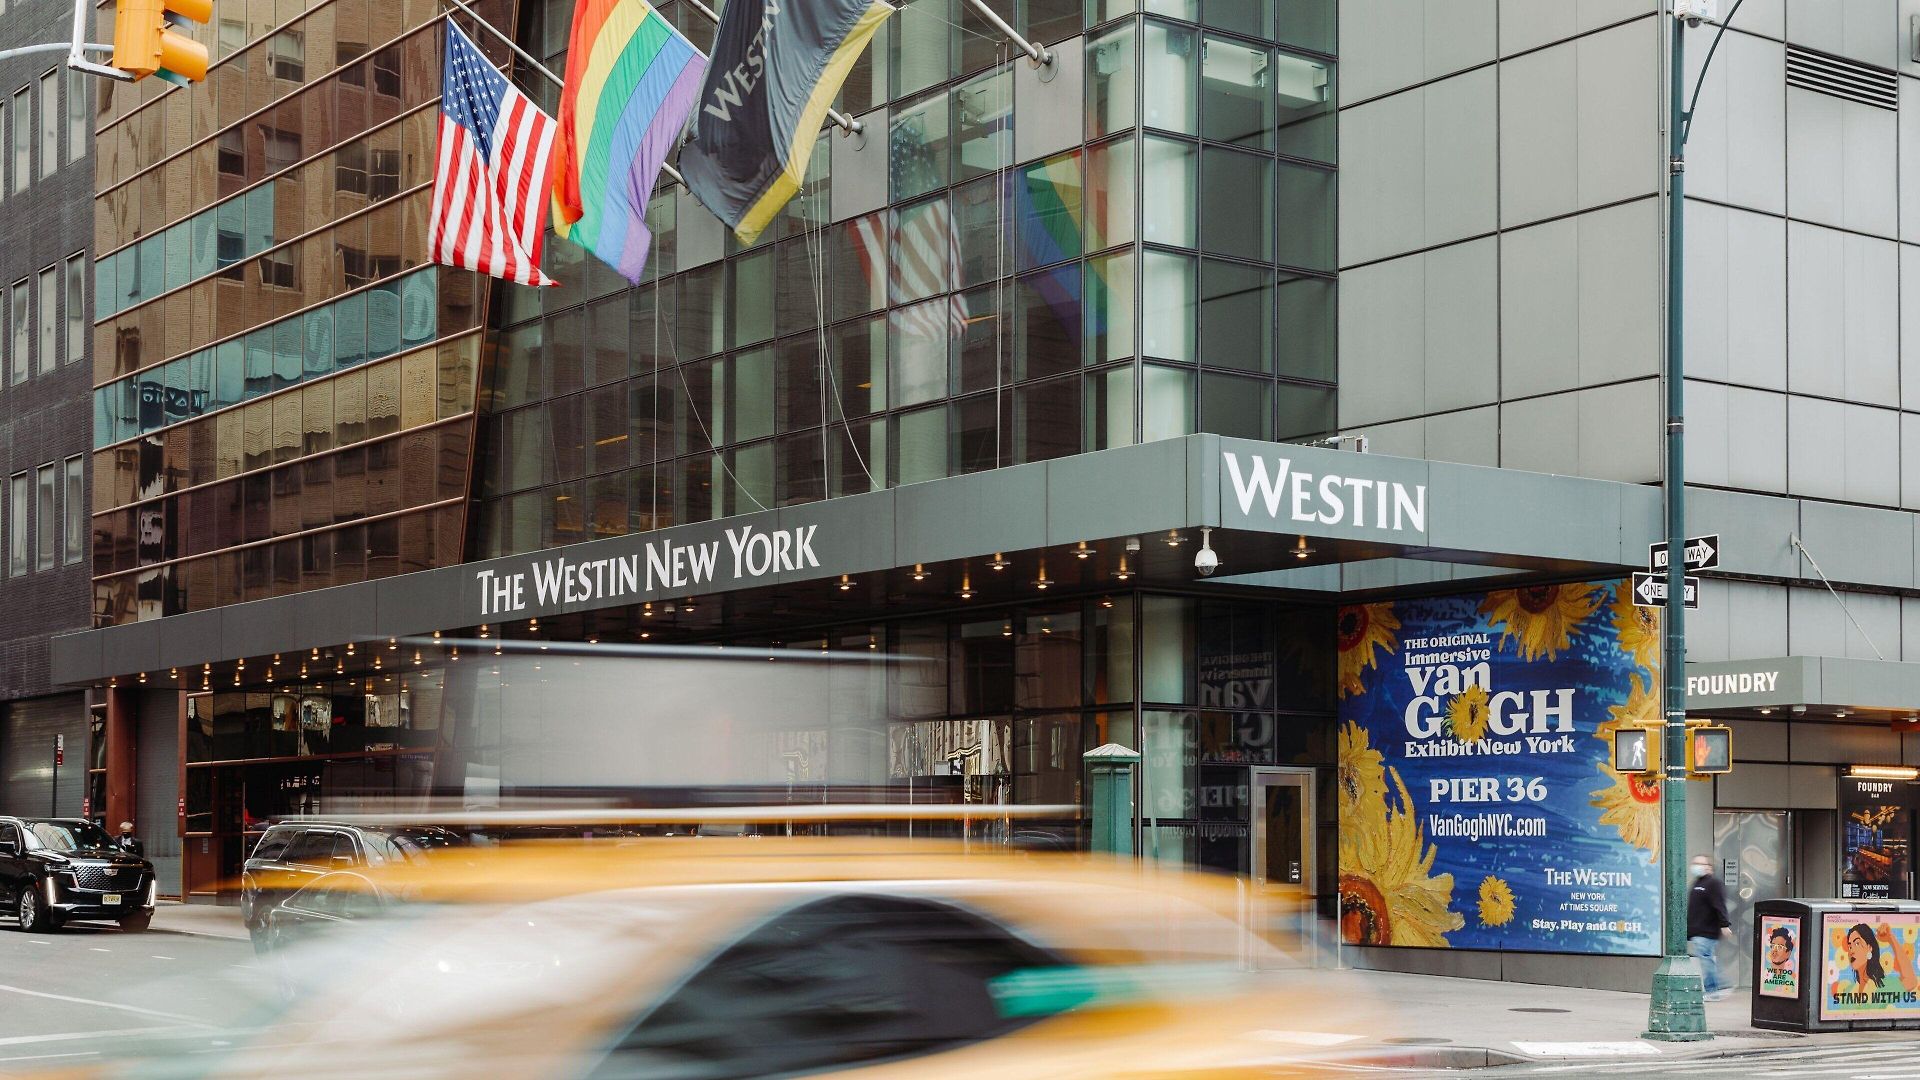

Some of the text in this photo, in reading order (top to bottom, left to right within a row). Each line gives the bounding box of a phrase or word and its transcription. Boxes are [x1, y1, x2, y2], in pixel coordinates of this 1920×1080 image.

[1224, 452, 1426, 533] WESTIN
[1687, 547, 1708, 561] WAY
[476, 524, 821, 615] THE WESTIN NEW YORK
[1643, 584, 1663, 597] ONE
[1404, 633, 1490, 650] THE ORIGINAL
[1405, 647, 1490, 666] Immersive
[1405, 661, 1492, 696] van
[1687, 671, 1779, 696] FOUNDRY
[1405, 688, 1576, 740] GGH
[1405, 735, 1576, 758] Exhibit New York
[1429, 776, 1548, 803] PIER 36
[1857, 782, 1893, 793] FOUNDRY
[1429, 813, 1546, 842] VanGoghNYC.com
[1544, 867, 1632, 887] THE WESTIN
[1571, 892, 1606, 901] NEW YORK
[1560, 903, 1618, 913] AT TIMES SQUARE
[1532, 919, 1642, 933] Stay, Play and GGH
[1767, 967, 1793, 975] WE TOO
[1764, 978, 1795, 987] AMERICA
[1833, 991, 1917, 1005] STAND WITH US
